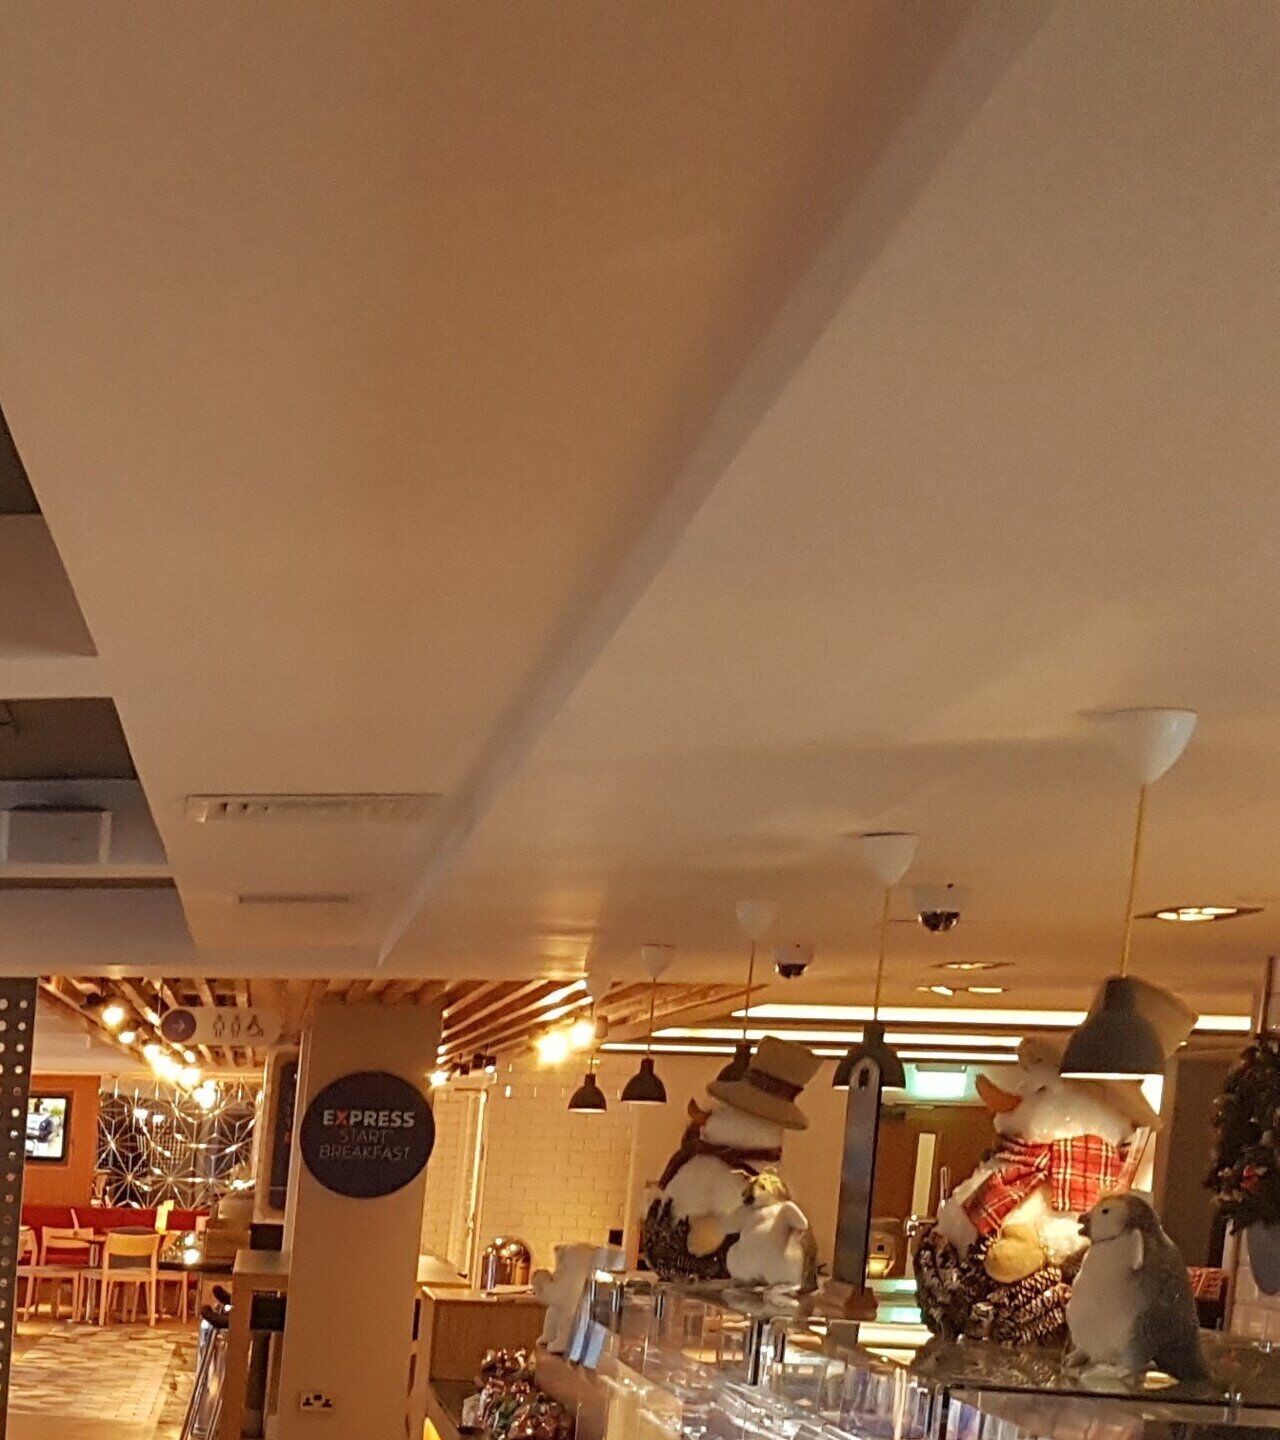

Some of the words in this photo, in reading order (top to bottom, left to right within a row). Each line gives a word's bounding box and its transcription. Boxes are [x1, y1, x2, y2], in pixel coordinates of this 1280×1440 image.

[322, 1109, 415, 1128] EXPRESS
[340, 1129, 389, 1144] START
[318, 1144, 410, 1160] BREAKFAST
